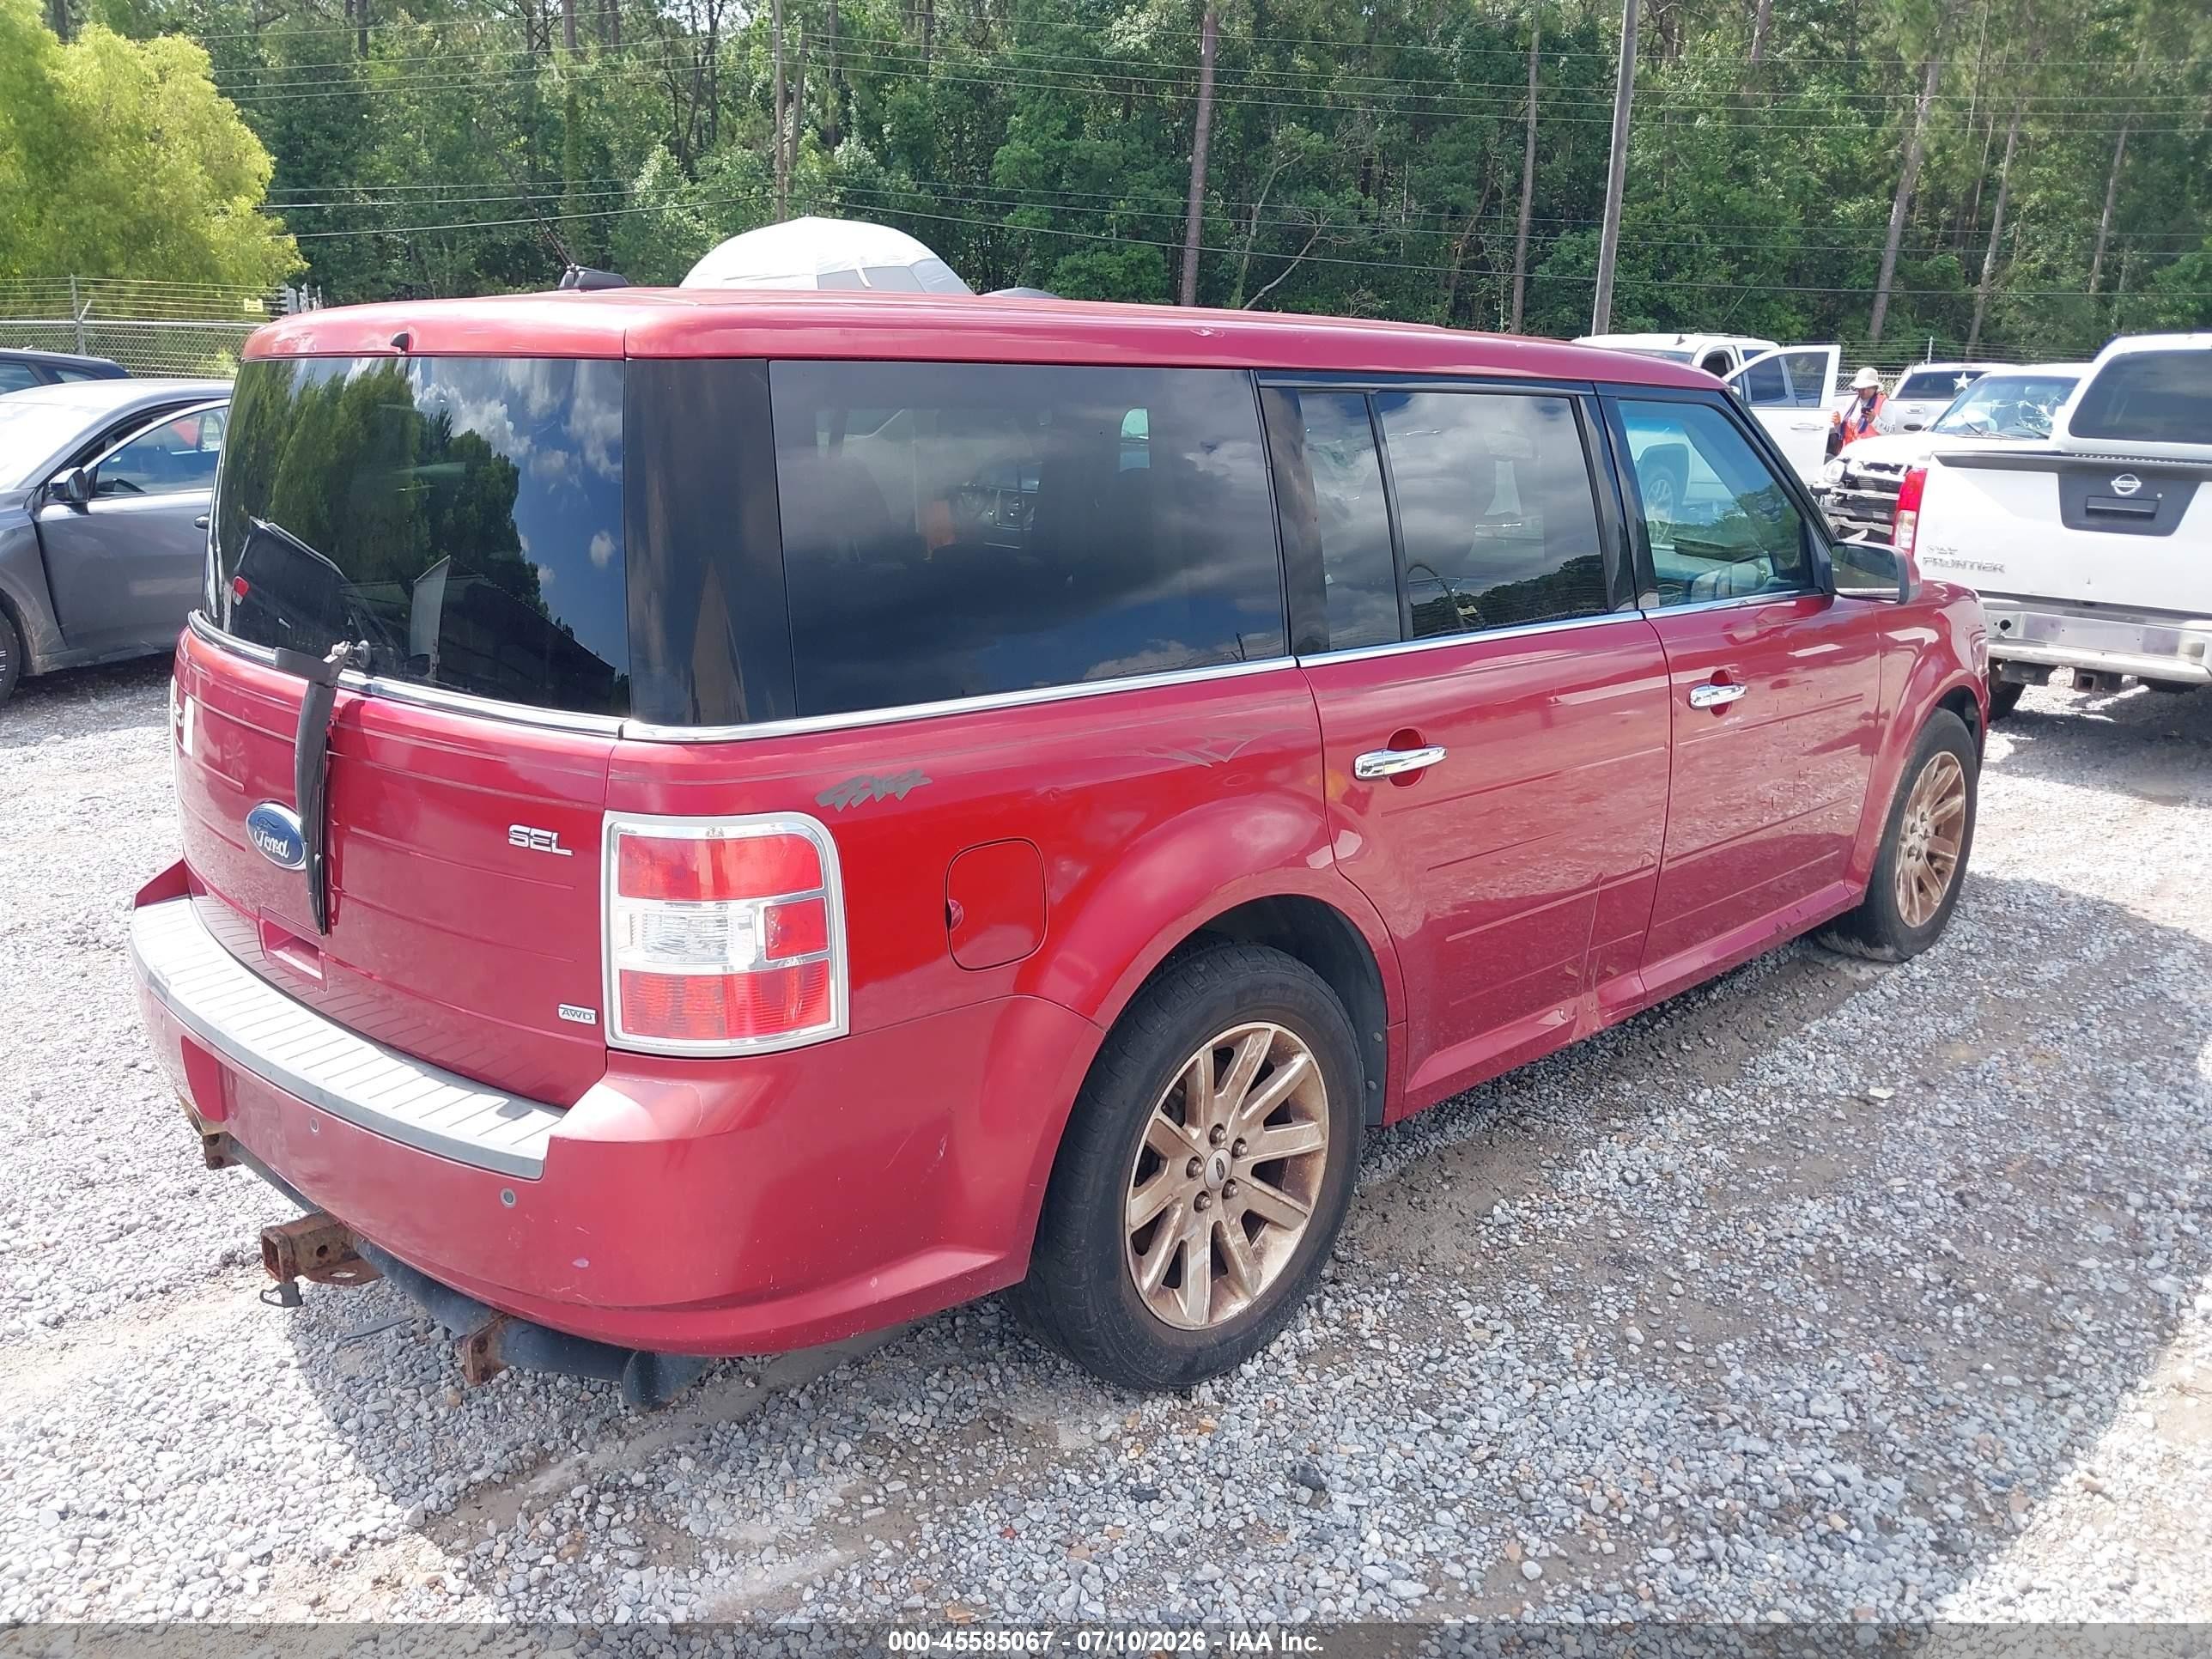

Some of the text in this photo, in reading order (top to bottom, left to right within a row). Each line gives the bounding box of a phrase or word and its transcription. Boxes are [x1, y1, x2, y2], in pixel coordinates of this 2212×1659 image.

[1923, 556, 2005, 574] FRONTIER
[254, 830, 289, 859] Ford
[508, 824, 574, 857] SEL
[562, 1008, 592, 1020] AWD
